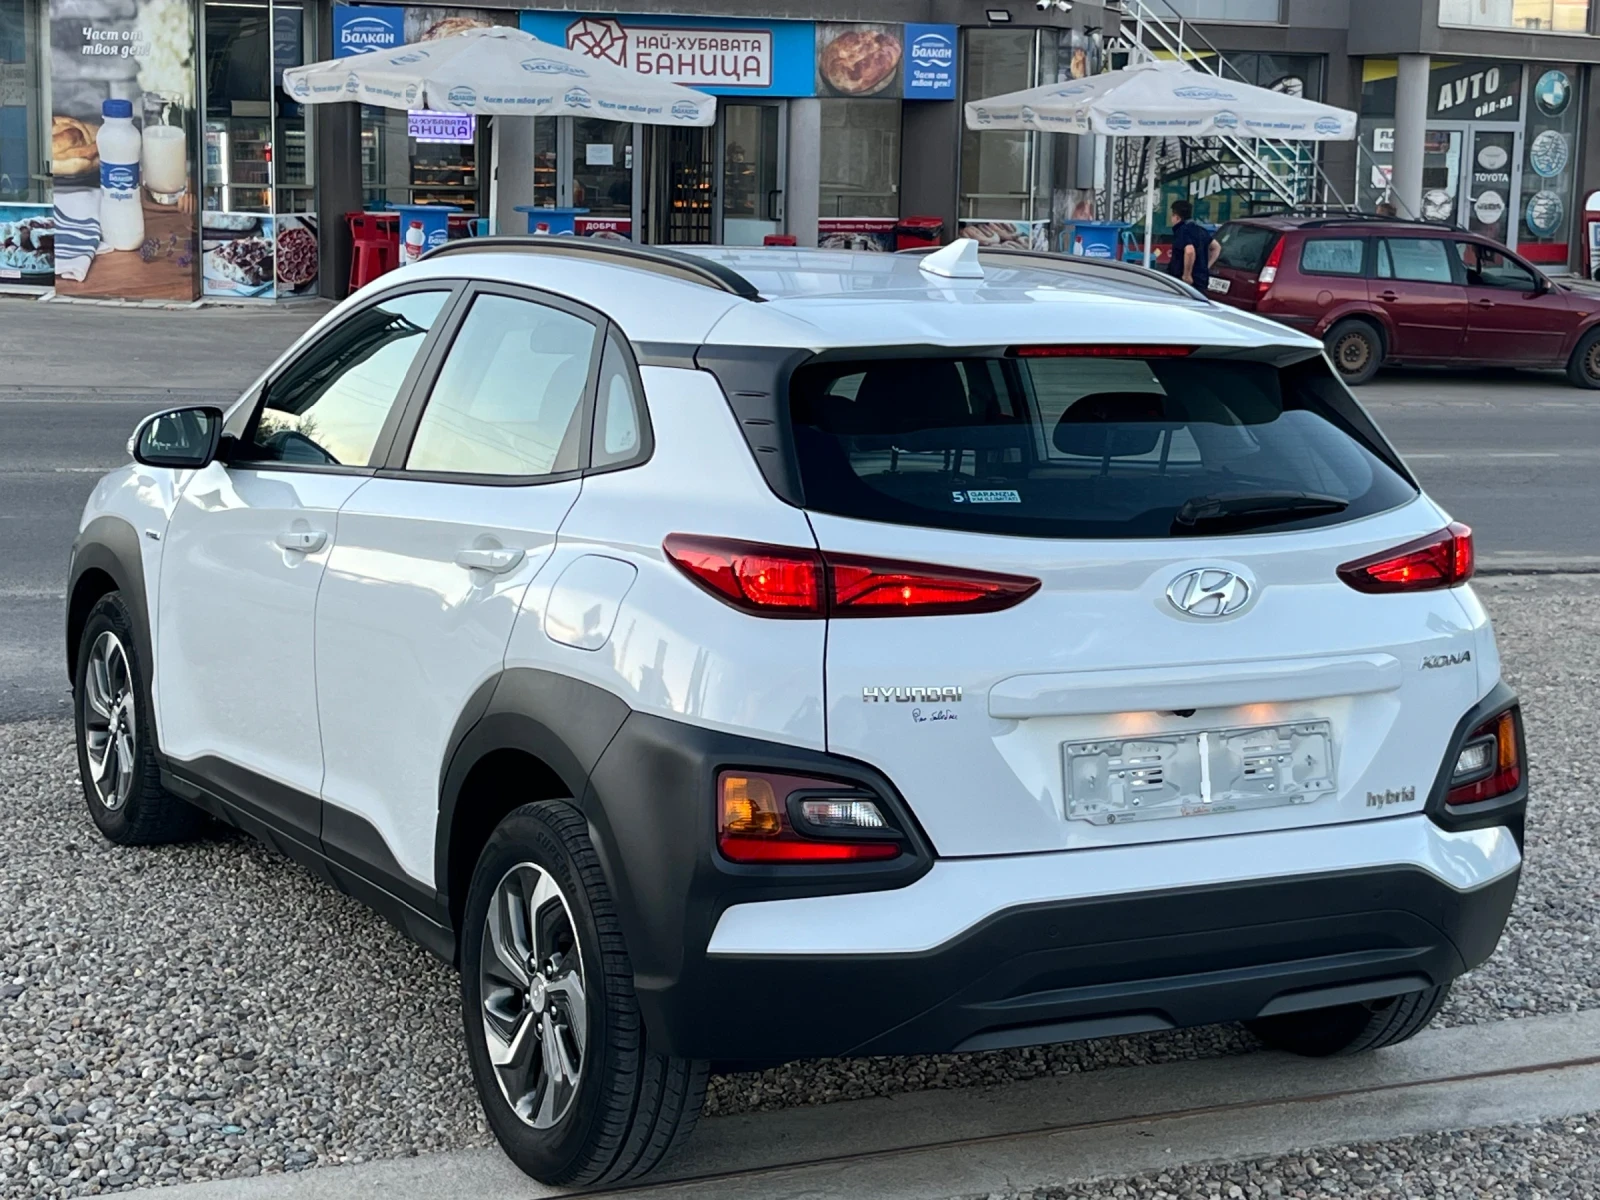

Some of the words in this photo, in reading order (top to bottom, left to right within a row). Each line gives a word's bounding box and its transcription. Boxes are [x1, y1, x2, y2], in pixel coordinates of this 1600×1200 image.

[82, 27, 119, 40] Част
[121, 31, 143, 41] от
[341, 29, 395, 44] Балкан
[636, 33, 762, 52] НАЙ-ХУБАВАТА
[82, 43, 119, 55] твоя
[121, 43, 152, 59] ден!
[911, 45, 952, 58] Балкан
[636, 52, 761, 82] БАНИЦА
[913, 70, 935, 79] Част
[911, 79, 933, 87] твоя
[933, 79, 952, 89] ден!
[448, 92, 477, 101] Балкан
[484, 96, 502, 104] Част
[537, 96, 553, 106] ден!
[564, 95, 591, 103] Балкан
[598, 100, 616, 109] Част
[671, 106, 699, 115] Балкан
[1475, 173, 1509, 182] TOYOTA
[586, 222, 617, 231] ДОБРЕ
[952, 491, 965, 503] 5
[1419, 650, 1471, 671] KONA
[863, 686, 963, 702] HYUNDAI
[1366, 786, 1416, 809] hybrid
